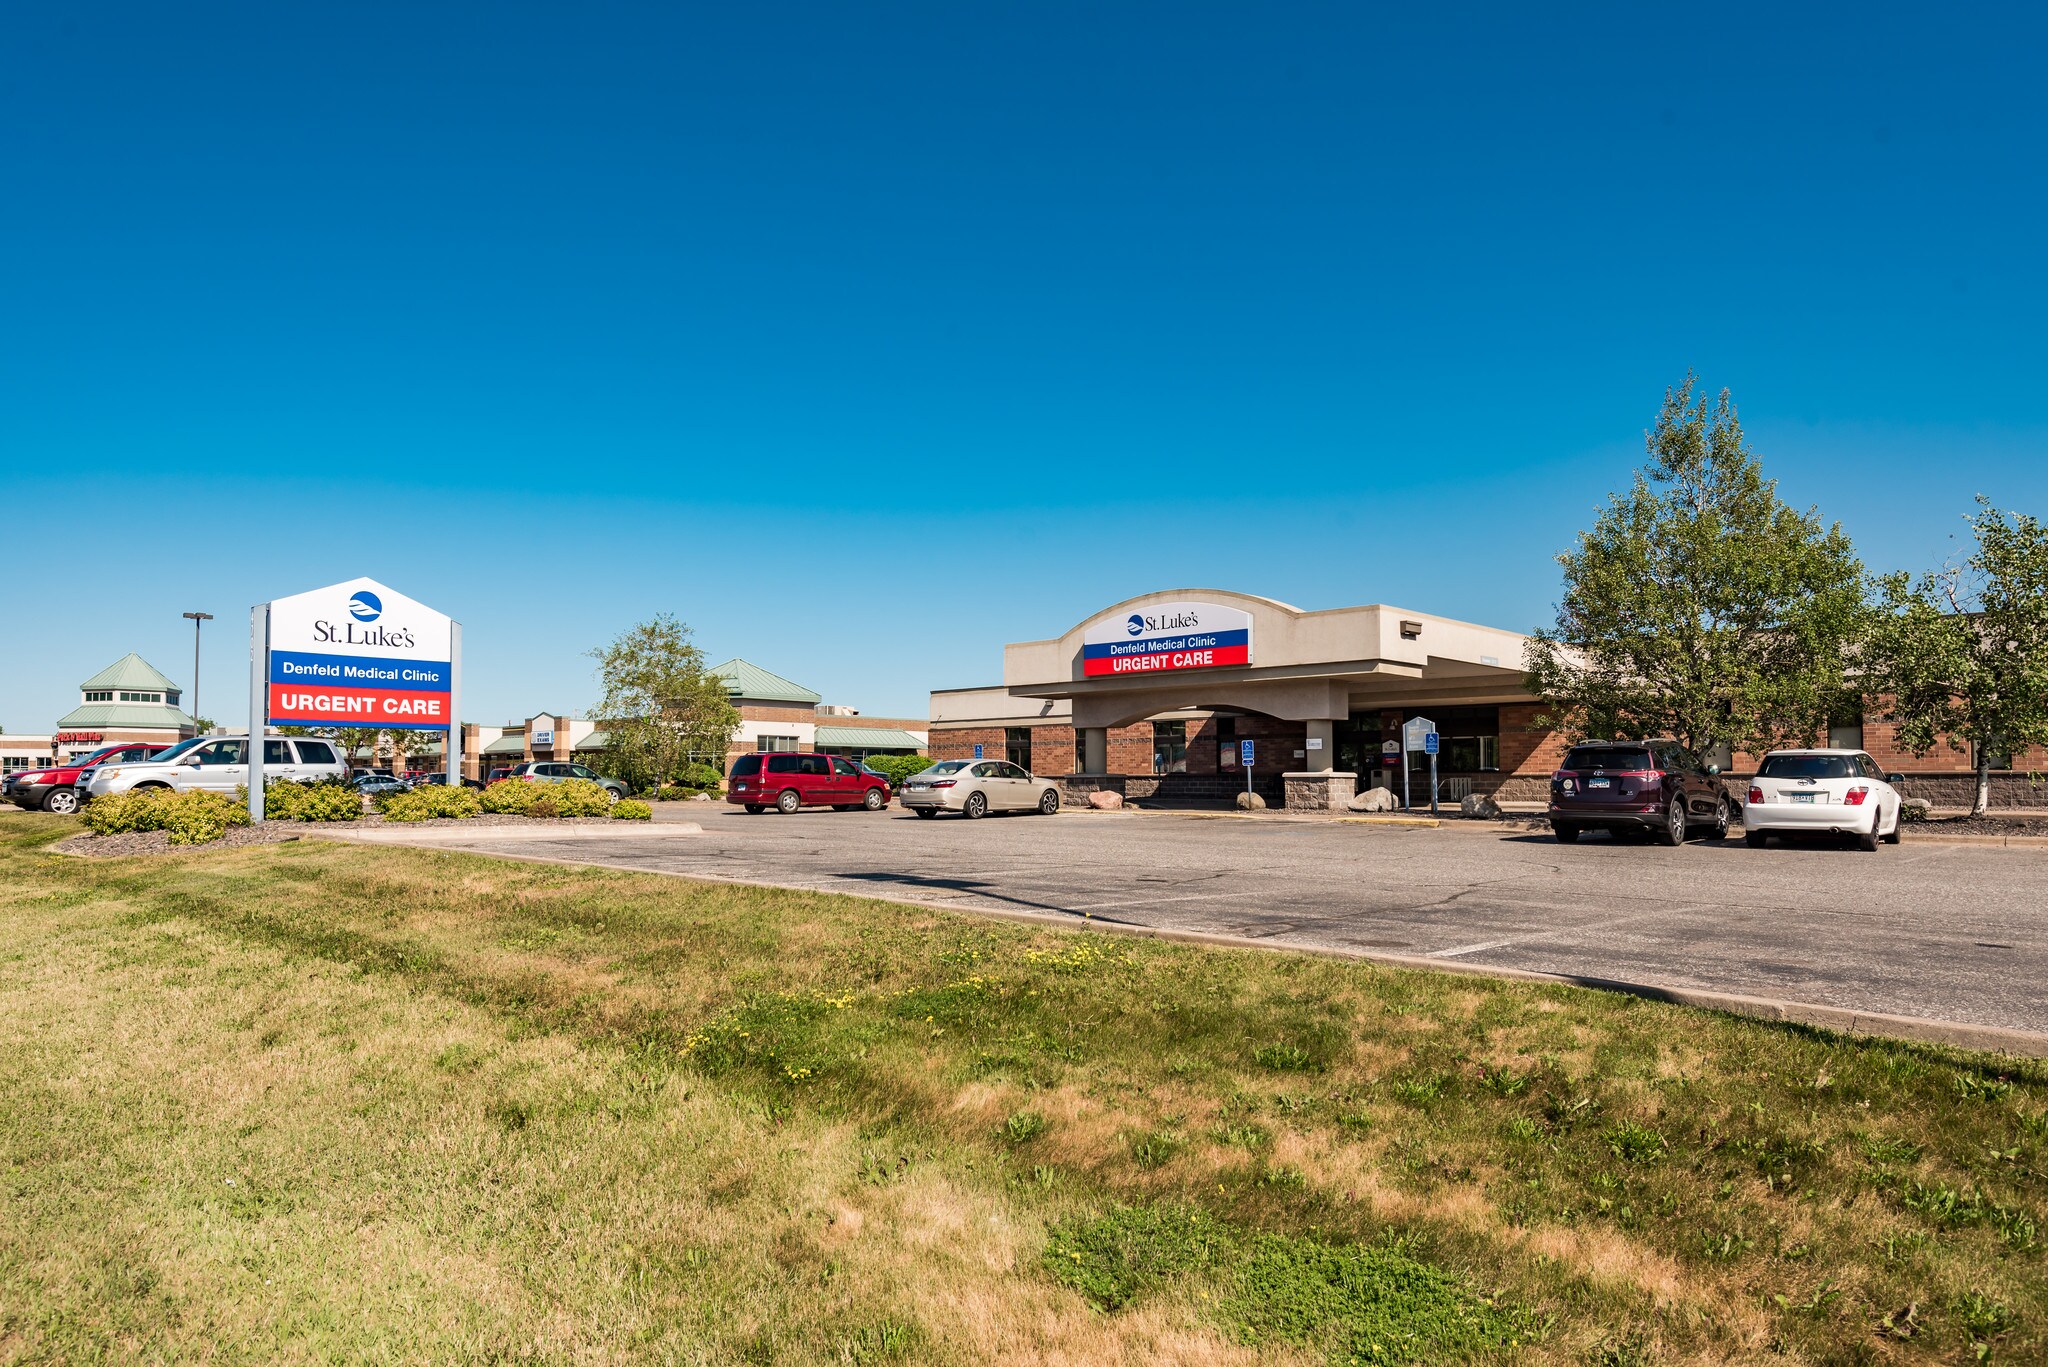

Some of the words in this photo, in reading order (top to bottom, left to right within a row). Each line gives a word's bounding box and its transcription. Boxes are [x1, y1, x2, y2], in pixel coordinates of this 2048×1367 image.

[1145, 616, 1160, 632] St.
[1161, 611, 1199, 630] Luke's
[313, 620, 342, 644] St.
[345, 622, 415, 649] Luke's
[1110, 642, 1146, 655] Denfeld
[1148, 639, 1186, 652] Medical
[1187, 635, 1216, 648] Clinic
[283, 661, 340, 677] Denfeld
[344, 665, 399, 681] Medical
[402, 669, 440, 682] Clinic
[1113, 654, 1170, 672] URGENT
[1172, 650, 1213, 668] CARE
[281, 692, 377, 713] URGENT
[382, 698, 441, 716] CARE
